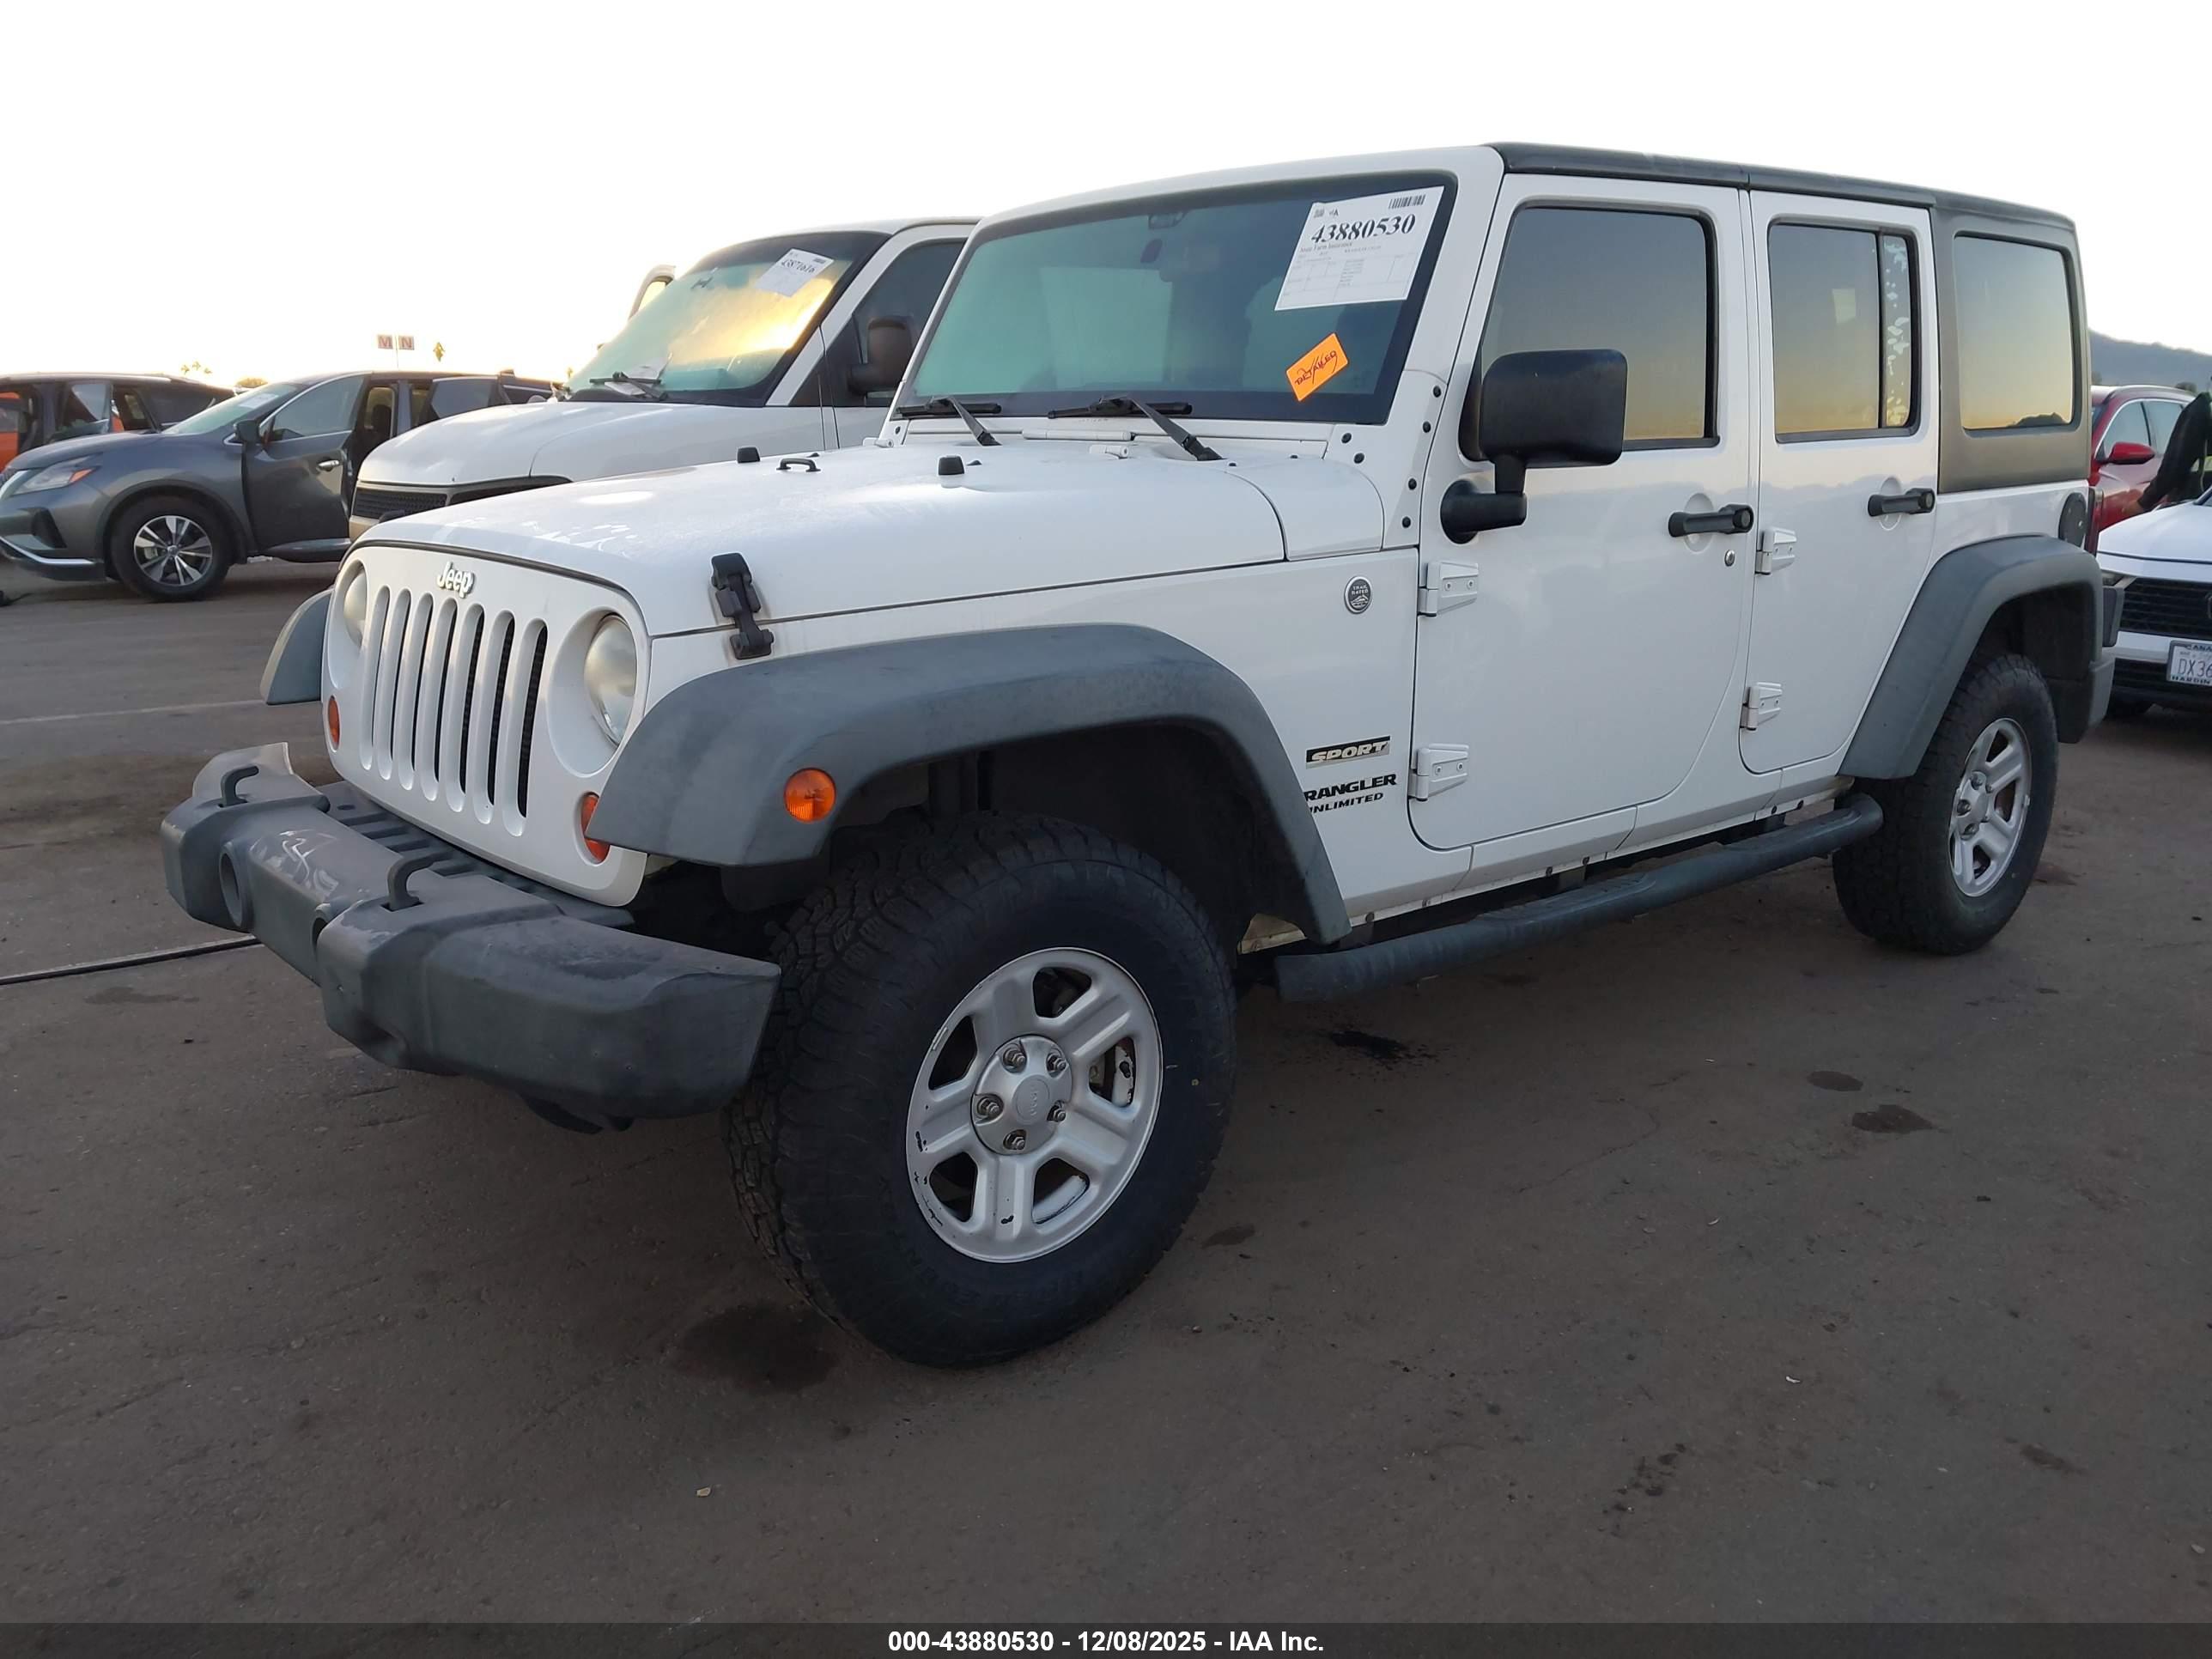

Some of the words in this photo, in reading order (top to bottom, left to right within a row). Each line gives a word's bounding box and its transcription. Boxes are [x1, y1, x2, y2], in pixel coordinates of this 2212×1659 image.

[1311, 214, 1416, 243] 43880530
[379, 336, 392, 347] M
[401, 337, 412, 349] N
[437, 562, 475, 599] Jeep
[1311, 742, 1389, 763] SPORT
[1304, 774, 1397, 801] RANGLER
